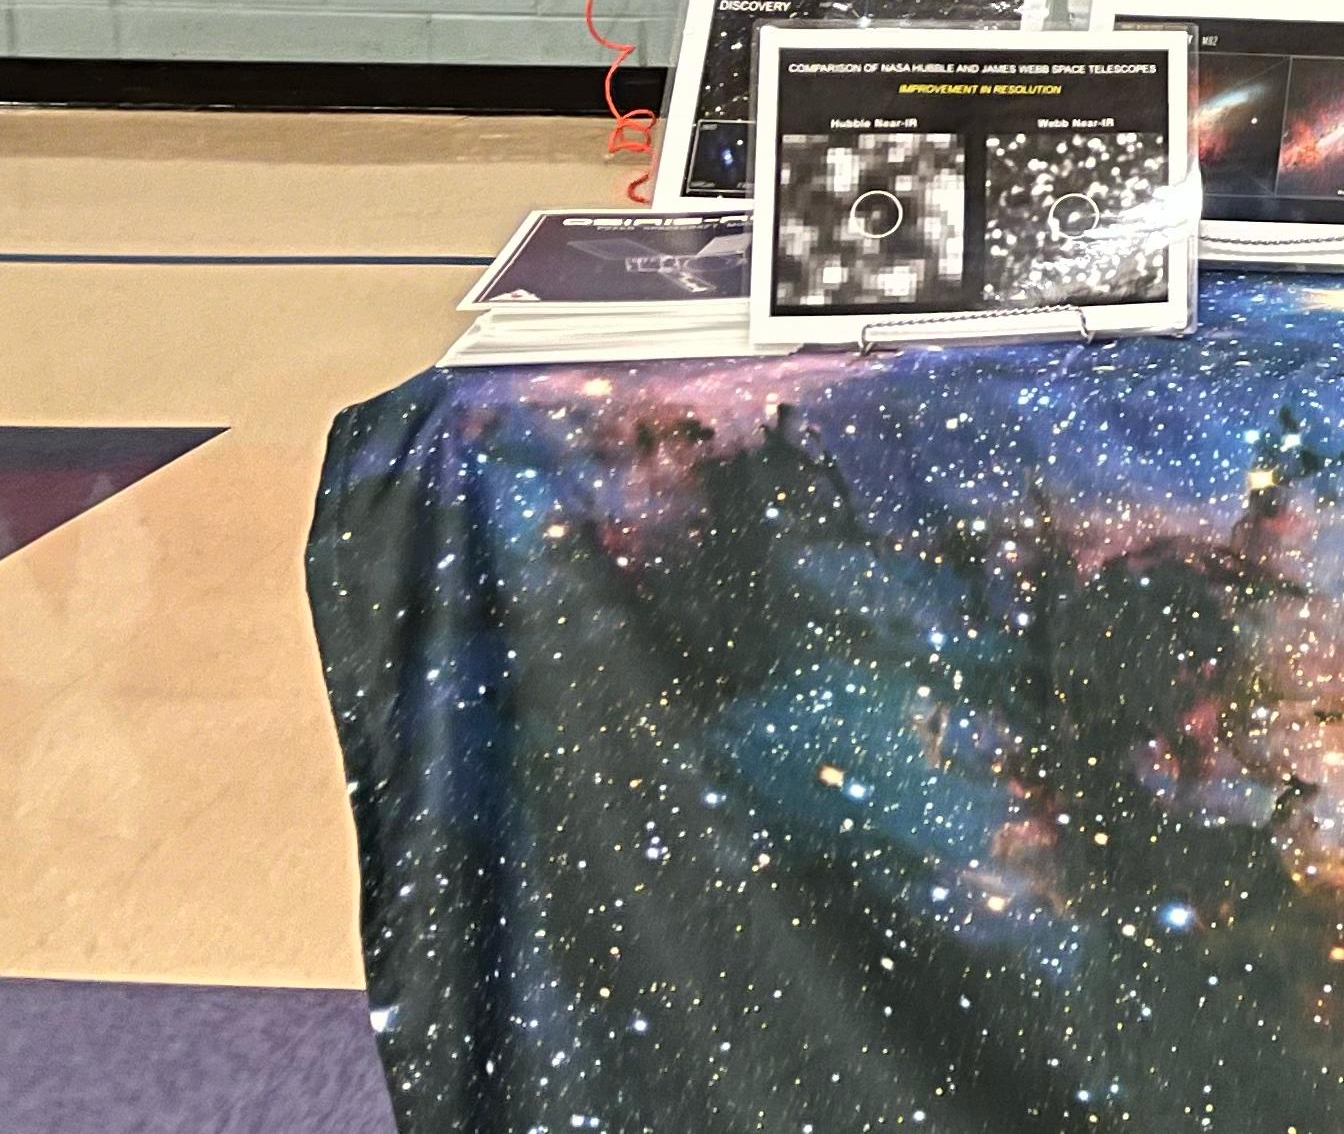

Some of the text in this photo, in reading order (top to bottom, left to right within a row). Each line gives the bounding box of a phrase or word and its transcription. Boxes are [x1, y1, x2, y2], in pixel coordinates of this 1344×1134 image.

[720, 0, 792, 12] DISCOVERY
[788, 64, 1157, 74] COMPARISON OF NASA HUBBLE AND JAMES WEBB SPACE TELESCOPES
[899, 84, 1062, 94] IMPROVEMENT IN RESOLUTION
[830, 118, 918, 128] Hubble Near-IR
[1037, 118, 1114, 128] Webb Near-IR
[563, 216, 753, 226] OSIRIS-R
